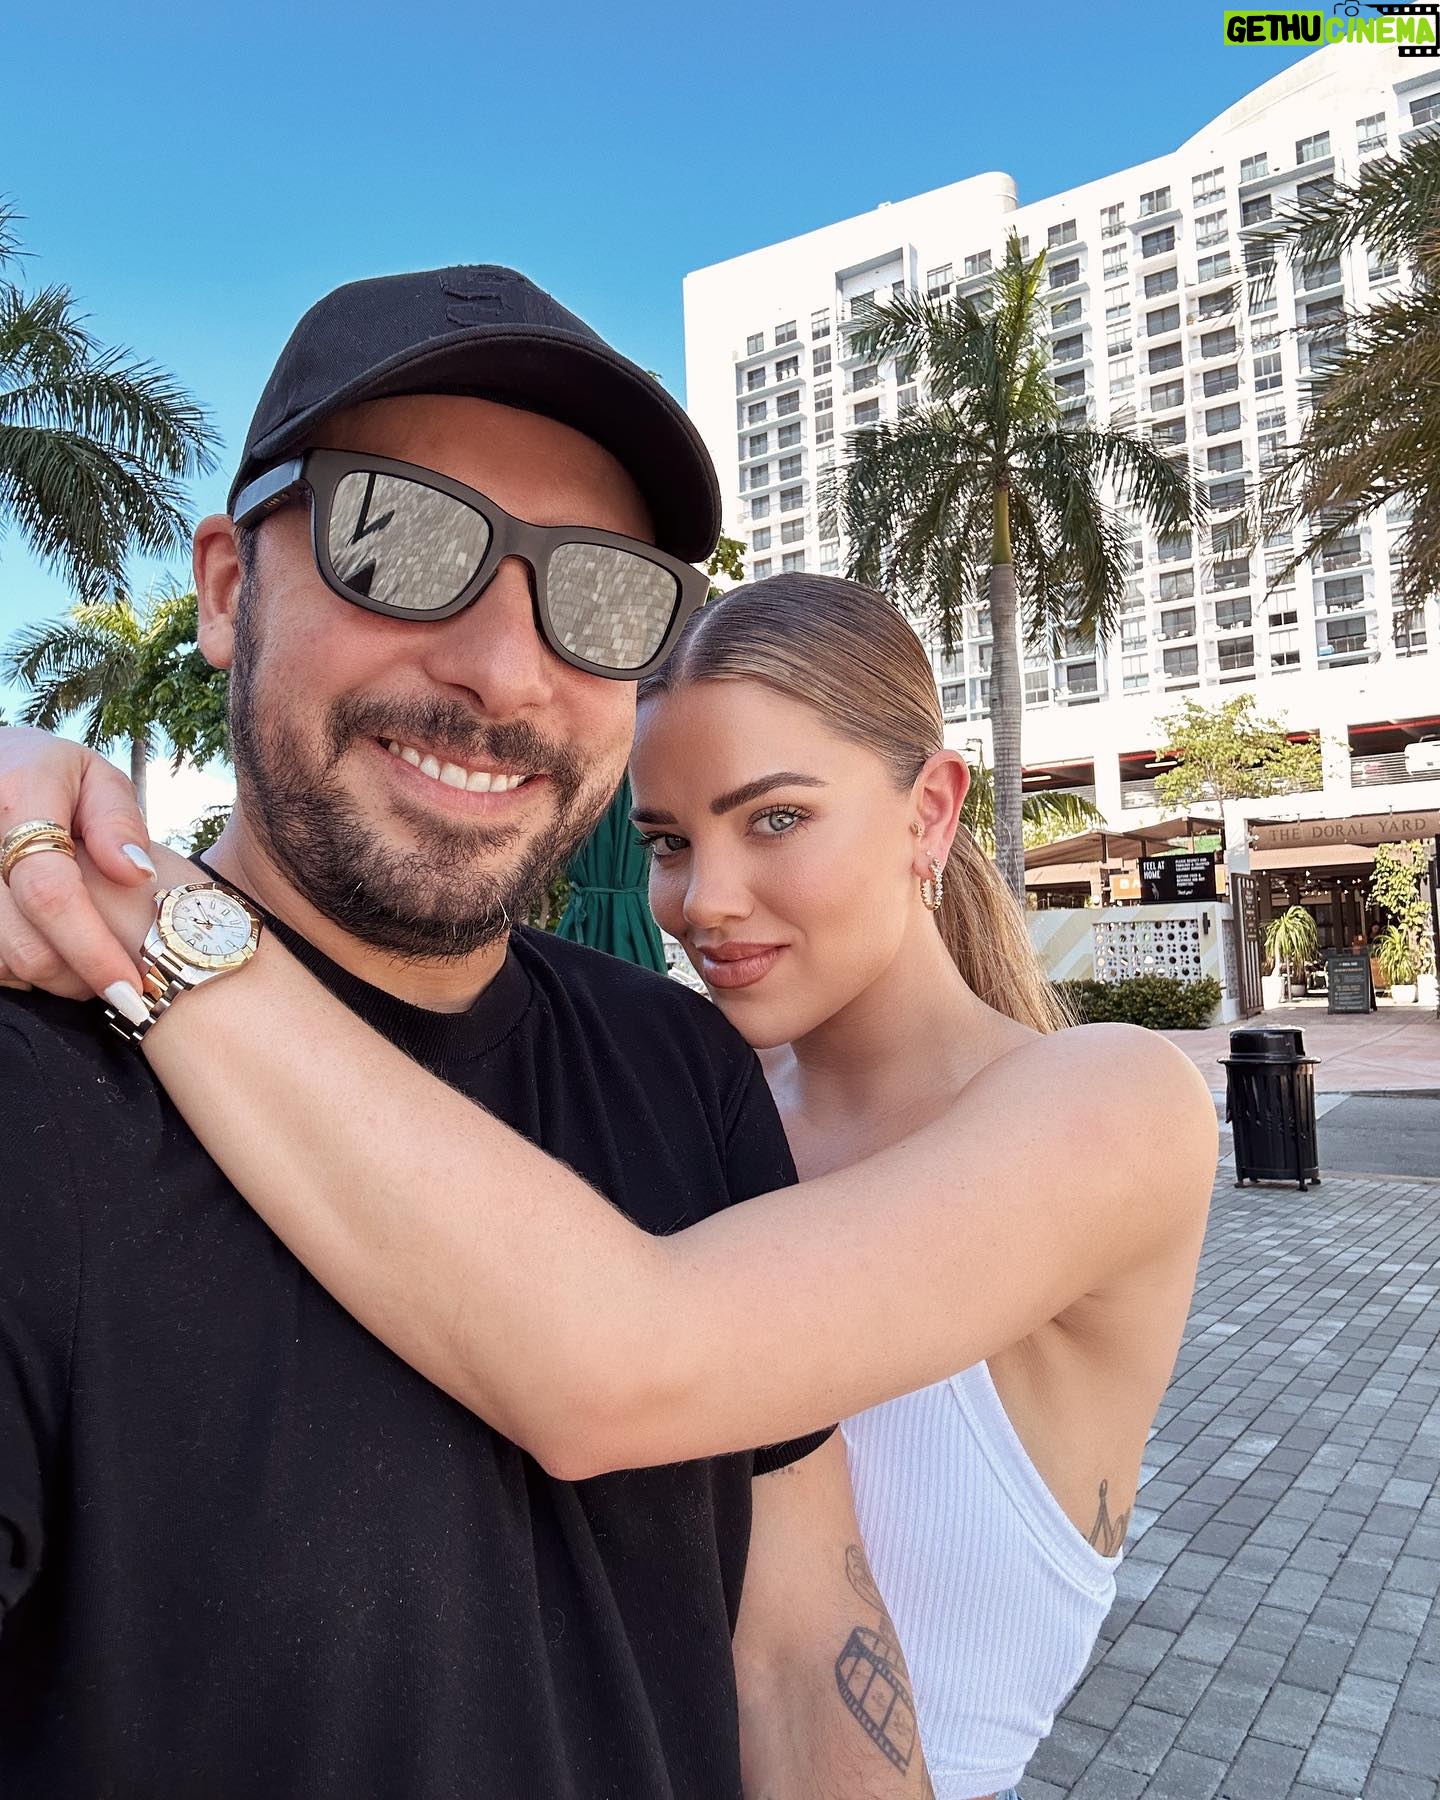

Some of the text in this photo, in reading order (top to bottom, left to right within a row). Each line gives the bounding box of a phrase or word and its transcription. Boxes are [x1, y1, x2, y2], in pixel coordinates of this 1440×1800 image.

[1269, 818, 1426, 841] THE DORAL YARD
[1143, 861, 1156, 870] FEEL
[1157, 860, 1165, 870] AT
[1143, 870, 1160, 880] HOME
